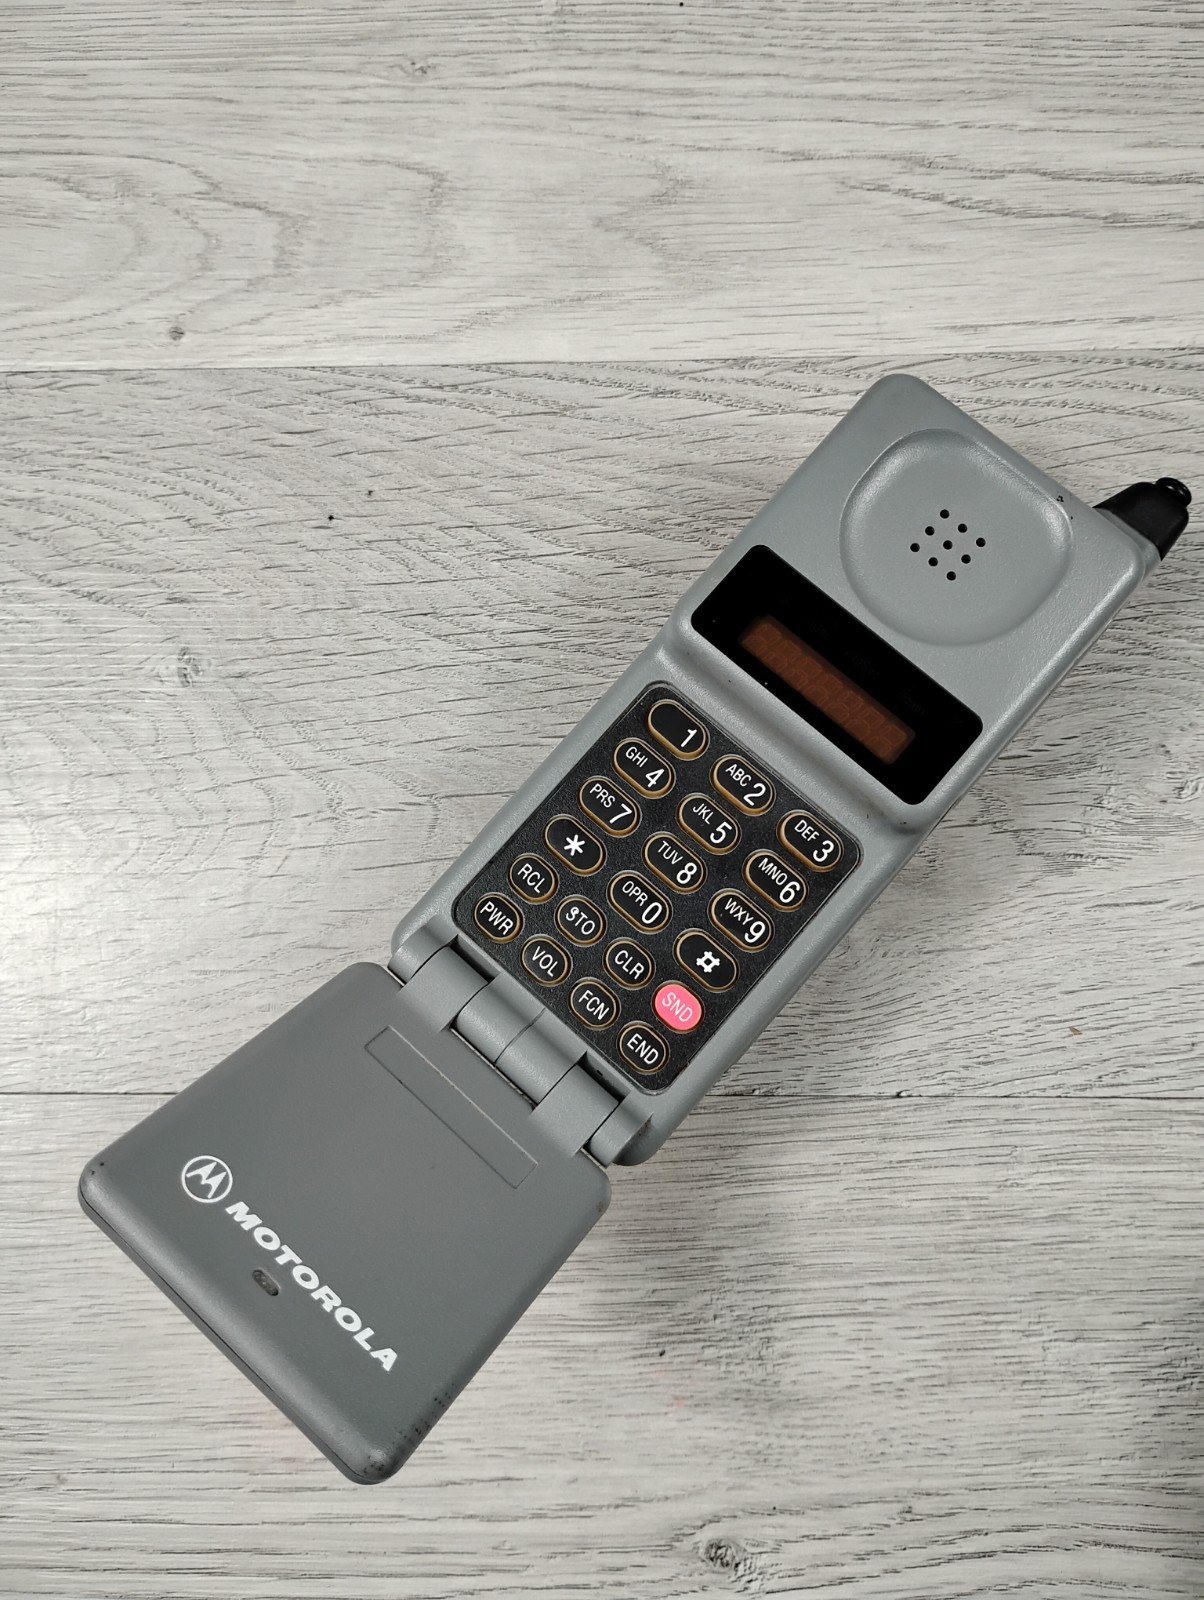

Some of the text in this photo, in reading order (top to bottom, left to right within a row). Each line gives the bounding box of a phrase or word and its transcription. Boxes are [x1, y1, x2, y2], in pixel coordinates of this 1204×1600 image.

[681, 729, 697, 747] 1
[625, 747, 664, 787] GHI 4
[726, 764, 766, 805] ABC 2
[590, 784, 632, 823] PRS 7
[693, 804, 732, 843] JKL 5
[795, 820, 834, 862] DEF 3
[518, 864, 544, 893] RCL
[658, 841, 697, 884] TUV 8
[759, 858, 800, 903] MNO 6
[480, 901, 513, 935] PWR
[566, 907, 595, 934] STO
[623, 881, 662, 923] OPR 0
[725, 898, 765, 942] WXY 9
[531, 946, 557, 976] VOL
[615, 950, 645, 979] CLR
[579, 990, 609, 1020] FCN
[662, 993, 693, 1021] SND
[627, 1034, 658, 1064] END
[225, 1201, 398, 1371] MOTOROLA
